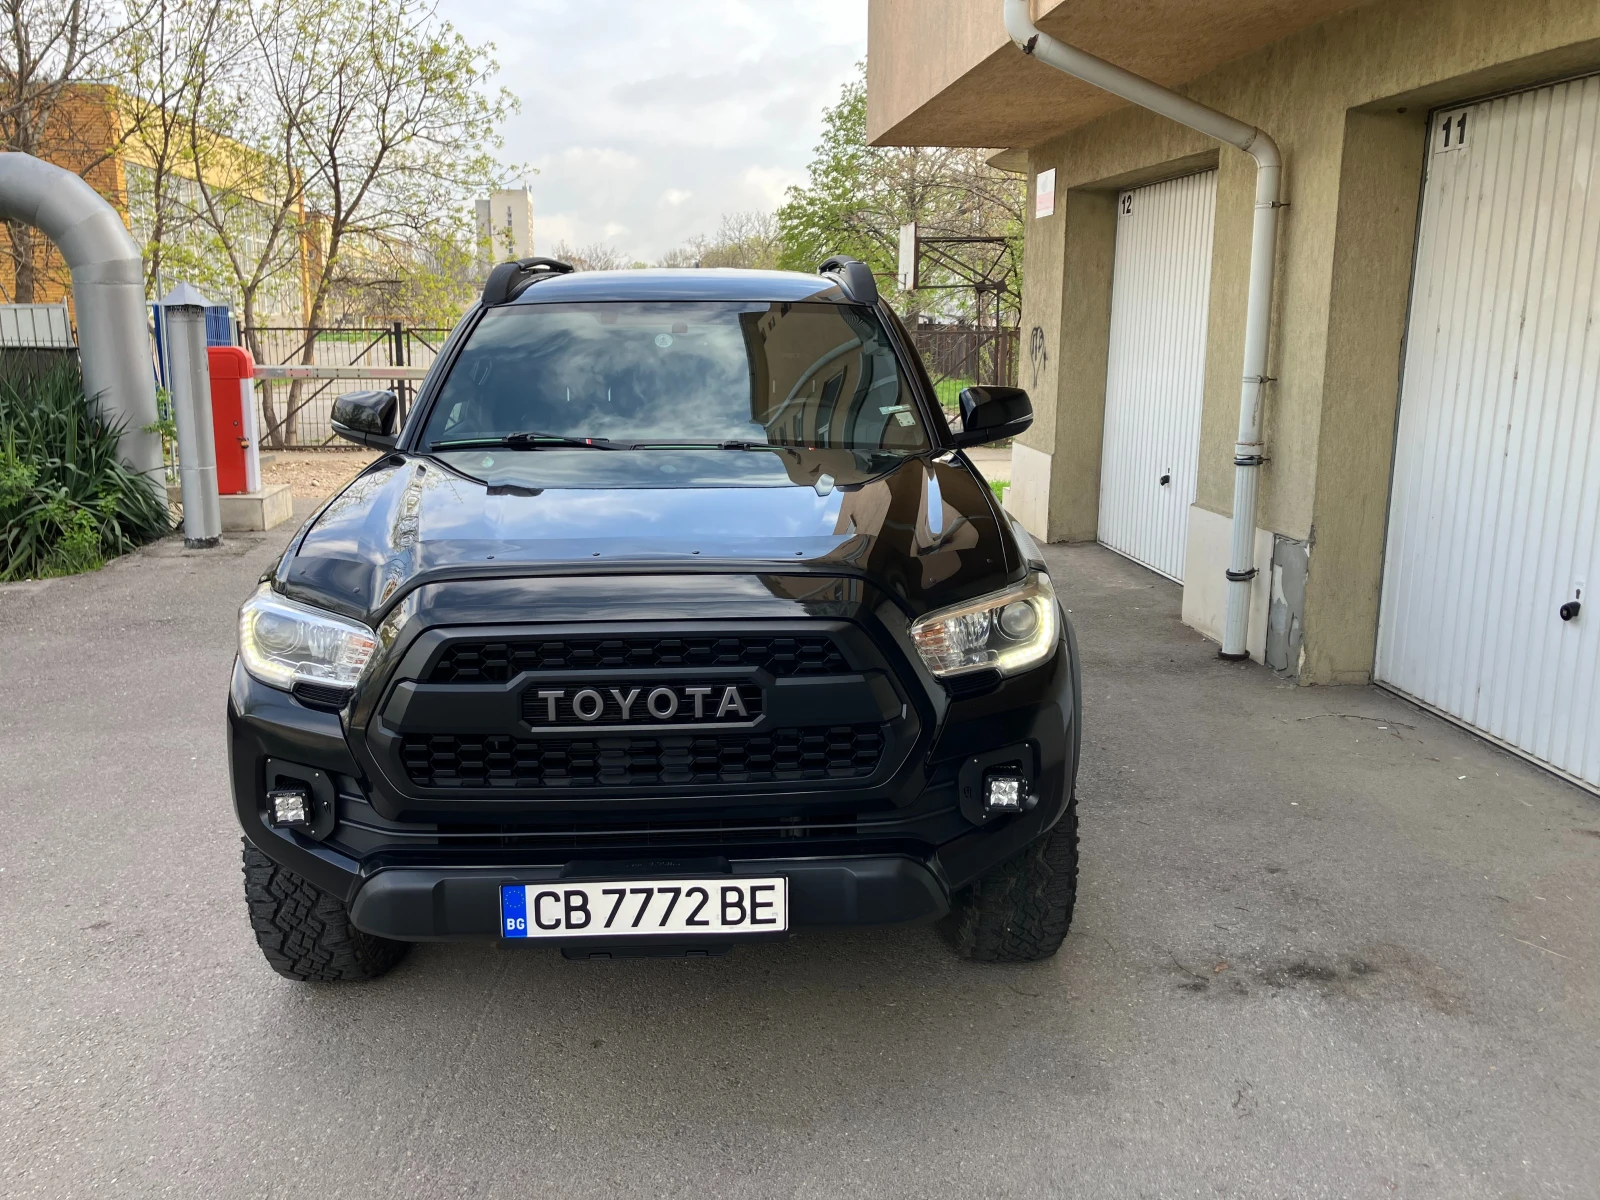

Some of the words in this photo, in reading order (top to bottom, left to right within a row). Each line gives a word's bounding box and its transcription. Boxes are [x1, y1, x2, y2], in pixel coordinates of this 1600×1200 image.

[1442, 112, 1468, 148] 11
[1121, 194, 1132, 215] 12
[537, 685, 749, 722] TOYOTA
[506, 918, 525, 931] BG
[533, 889, 592, 930] CB
[601, 886, 710, 929] 7772
[720, 884, 777, 926] BE
